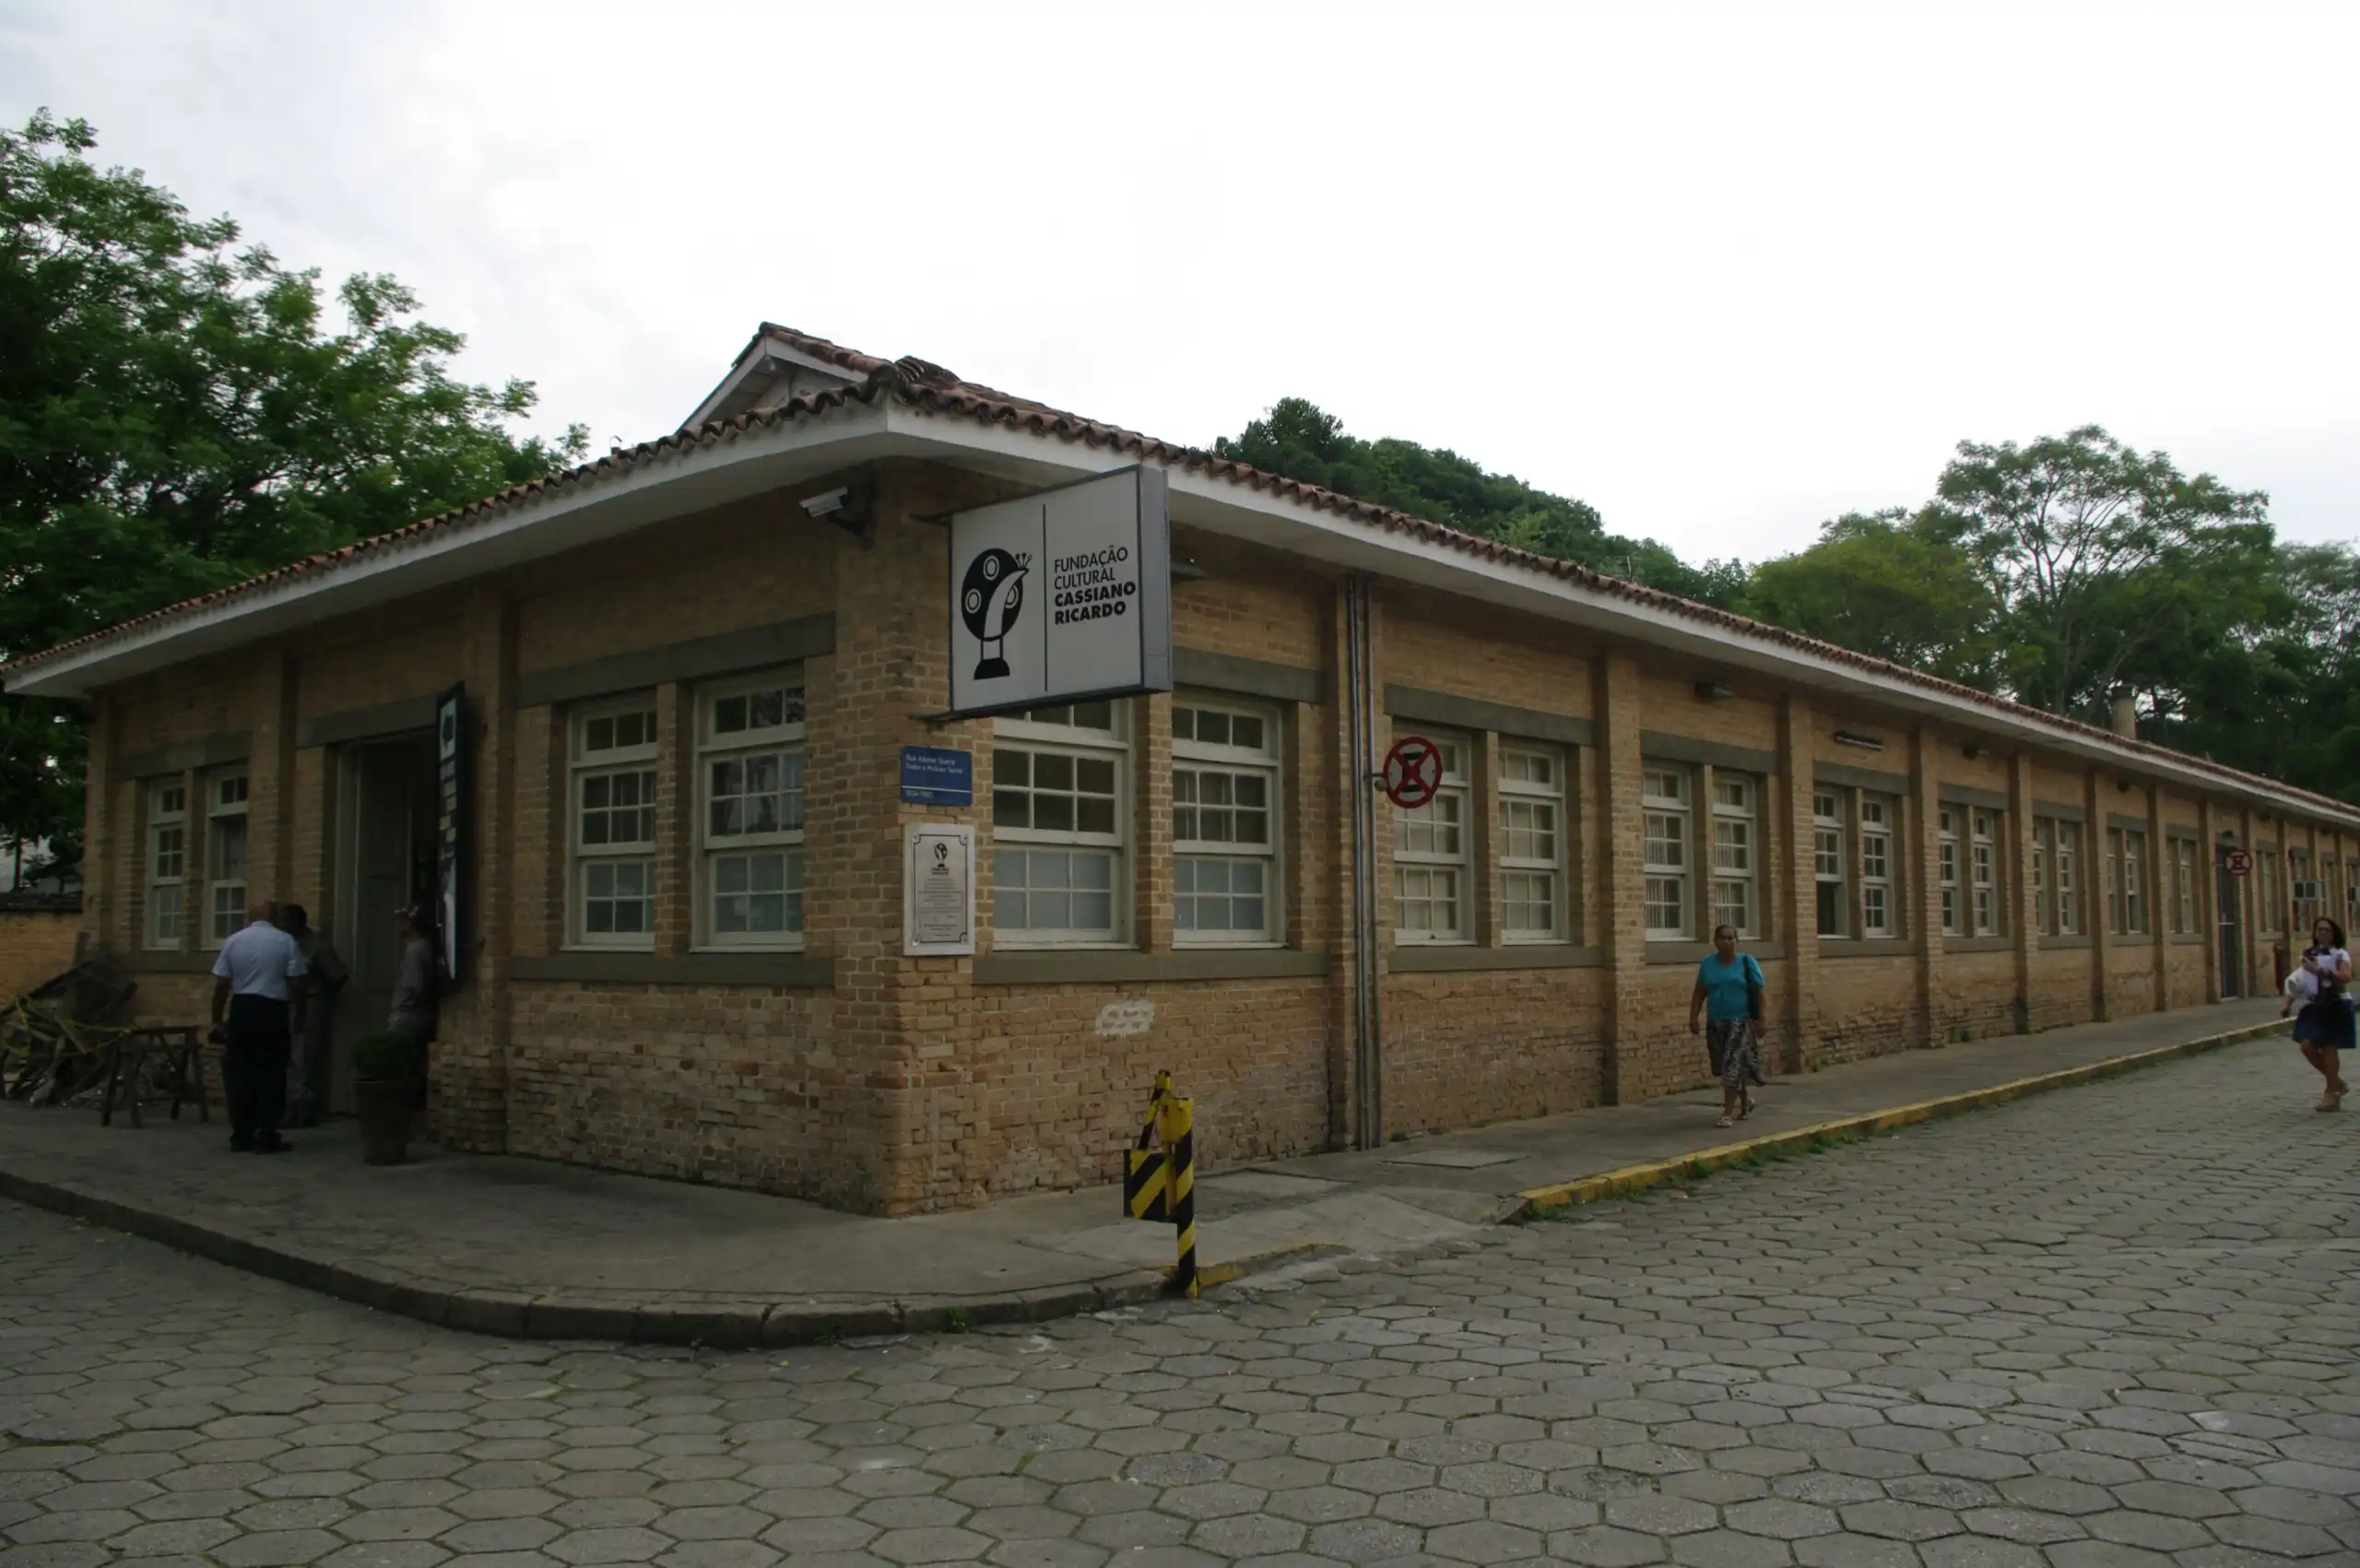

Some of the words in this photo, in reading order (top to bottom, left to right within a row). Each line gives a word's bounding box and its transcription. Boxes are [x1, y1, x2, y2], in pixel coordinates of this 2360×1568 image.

[1055, 545, 1128, 572] FUNDAÇÃO
[1055, 567, 1115, 590] CULTURAL
[1055, 581, 1136, 607] CASSIANO
[1055, 601, 1127, 625] RICARDO
